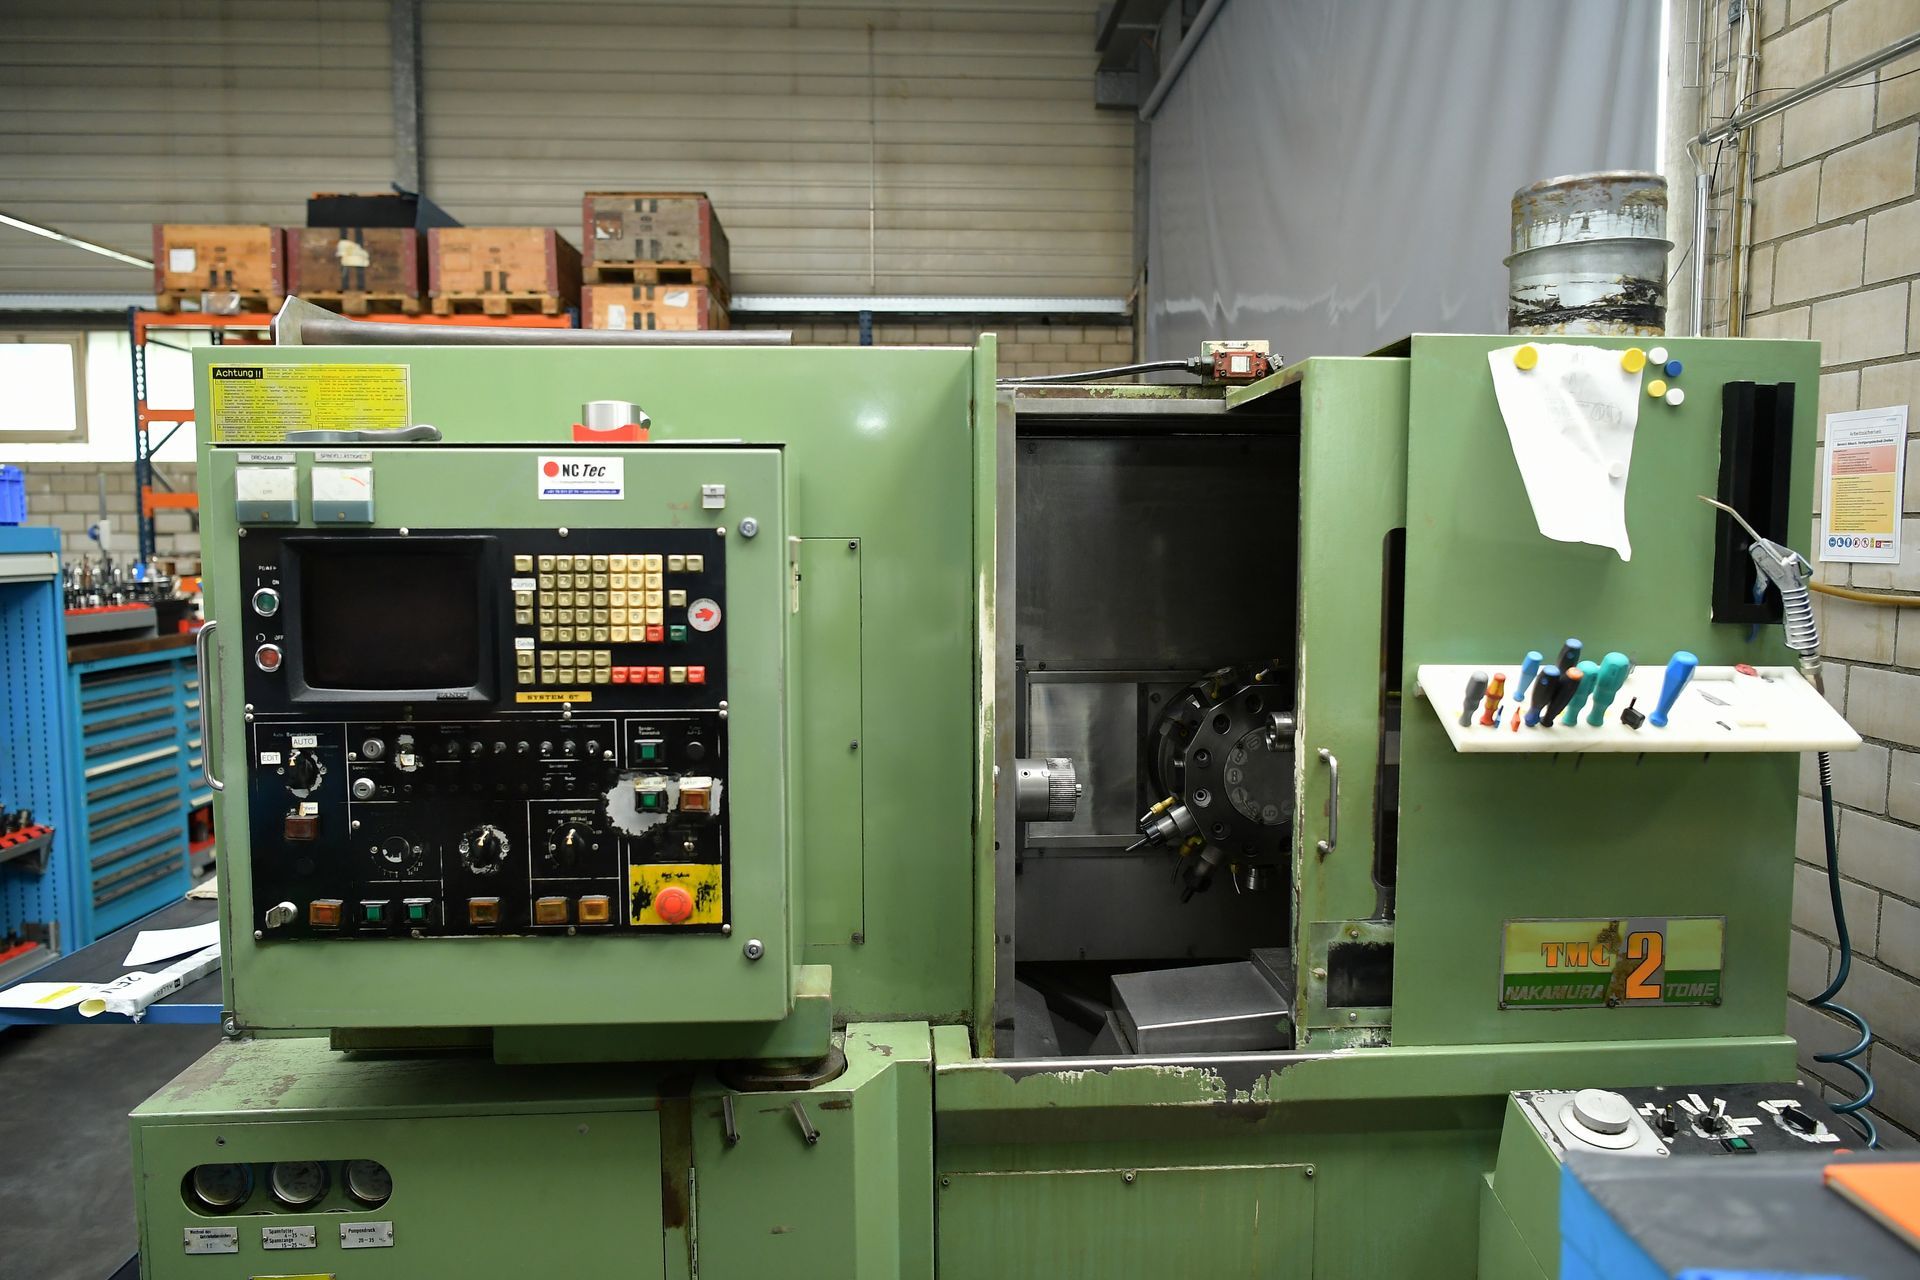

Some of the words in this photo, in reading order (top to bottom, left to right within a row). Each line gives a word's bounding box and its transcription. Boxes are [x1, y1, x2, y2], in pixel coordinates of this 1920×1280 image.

[216, 369, 254, 378] Achtung
[562, 464, 579, 477] NC
[582, 464, 606, 477] Tec
[262, 754, 279, 762] EDIT
[1541, 942, 1611, 967] TMC
[1625, 931, 1664, 1000] 2
[1505, 984, 1605, 1000] NAKAMURA
[1666, 982, 1717, 997] TOME
